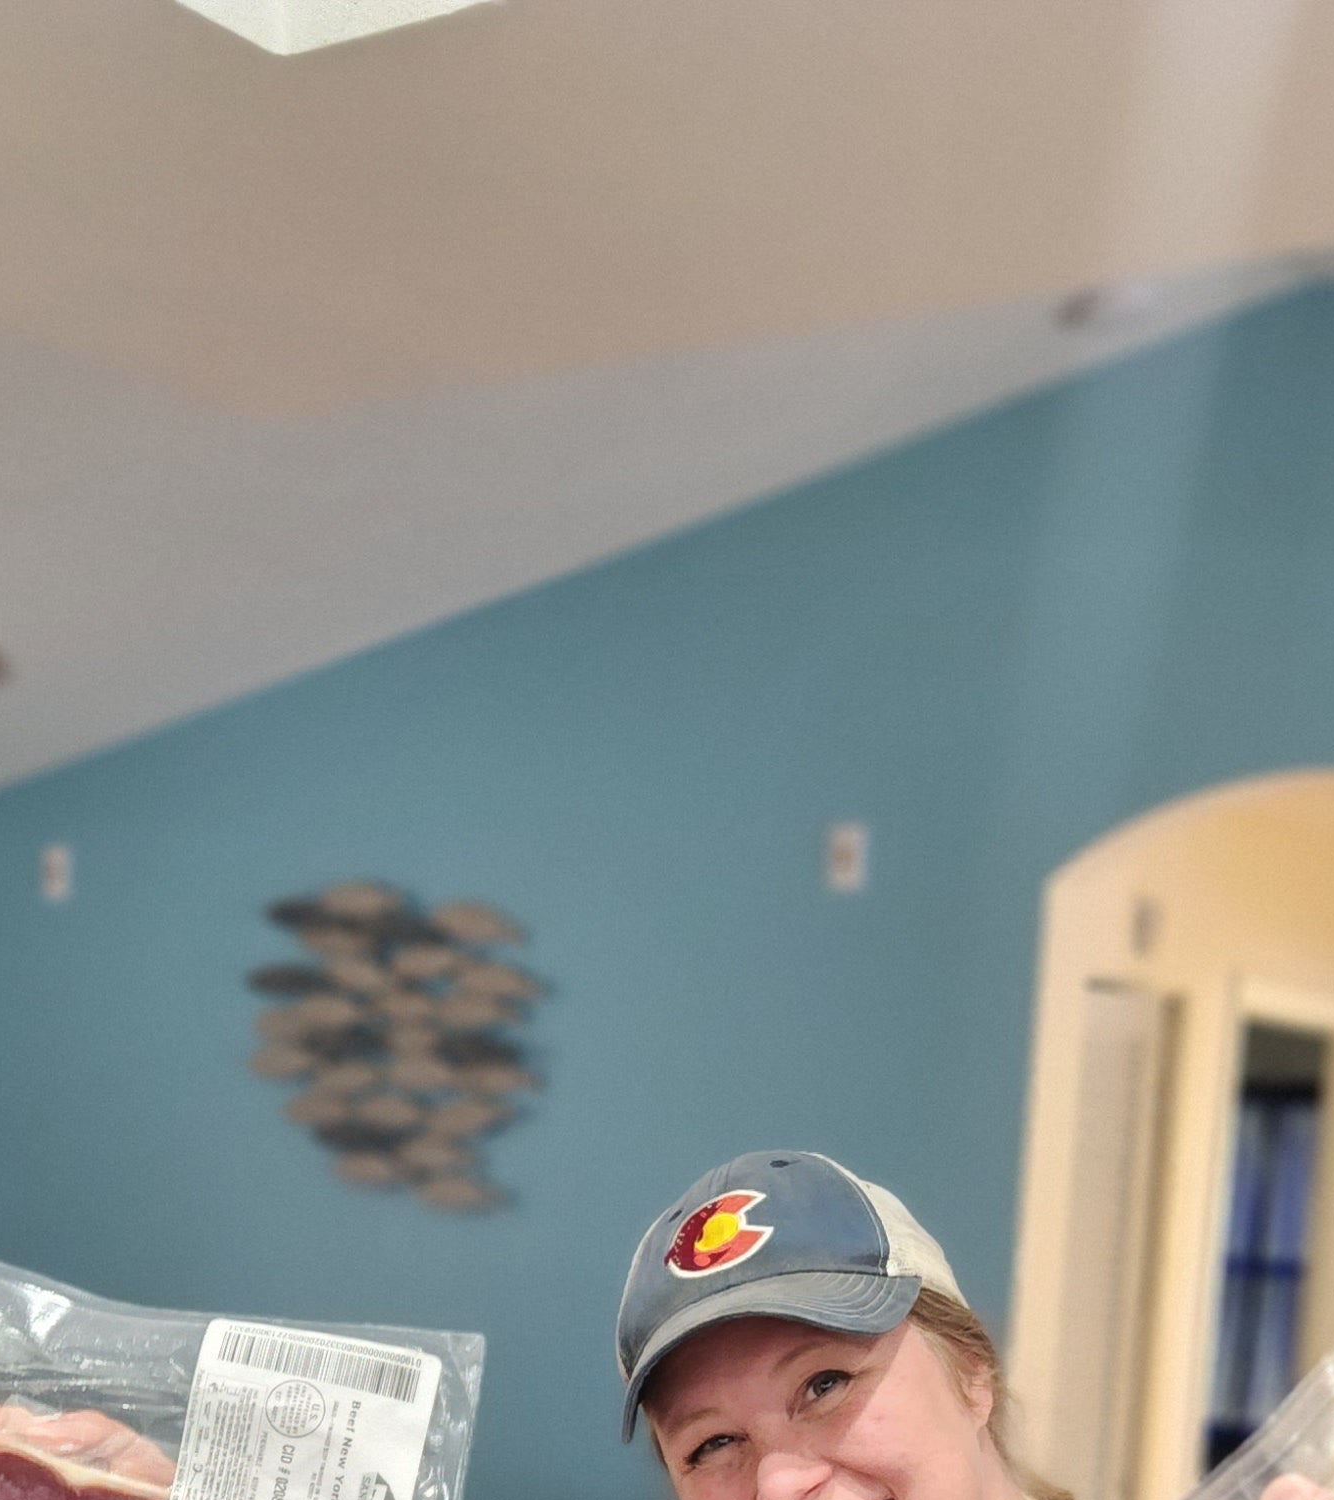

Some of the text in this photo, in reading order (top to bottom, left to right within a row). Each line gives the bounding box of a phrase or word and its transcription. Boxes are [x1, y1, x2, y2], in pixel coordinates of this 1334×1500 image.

[347, 1399, 361, 1432] Beef
[280, 1443, 295, 1464] CID
[338, 1436, 353, 1469] New
[278, 1465, 291, 1475] #
